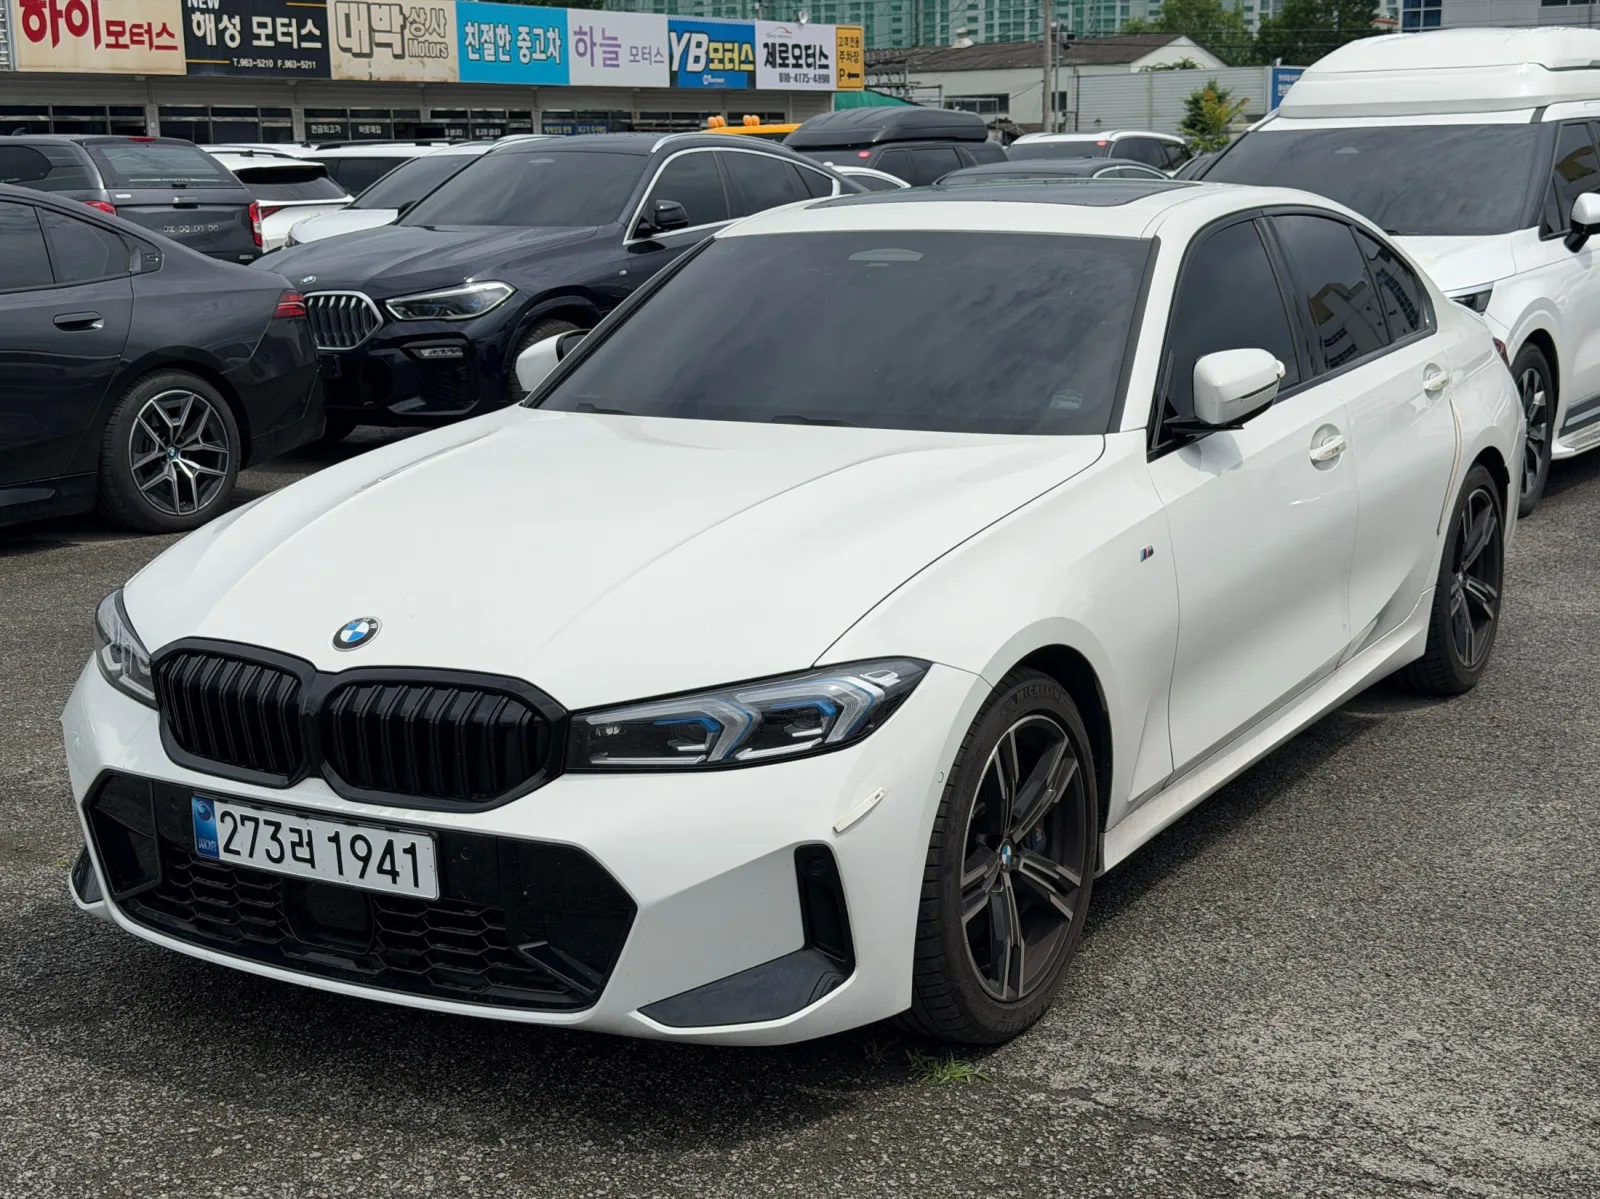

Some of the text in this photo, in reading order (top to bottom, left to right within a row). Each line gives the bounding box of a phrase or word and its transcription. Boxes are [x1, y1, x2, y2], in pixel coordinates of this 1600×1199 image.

[188, 0, 219, 9] NEW
[19, 0, 178, 52] 하이 모터스
[191, 11, 322, 49] 해성 모터스
[335, 1, 447, 60] 대박 상사
[464, 21, 562, 65] 친절한 중고차
[573, 26, 664, 68] 하늘 모터스
[407, 38, 449, 59] Motors
[839, 68, 846, 82] P
[219, 810, 420, 888] 273러 1941
